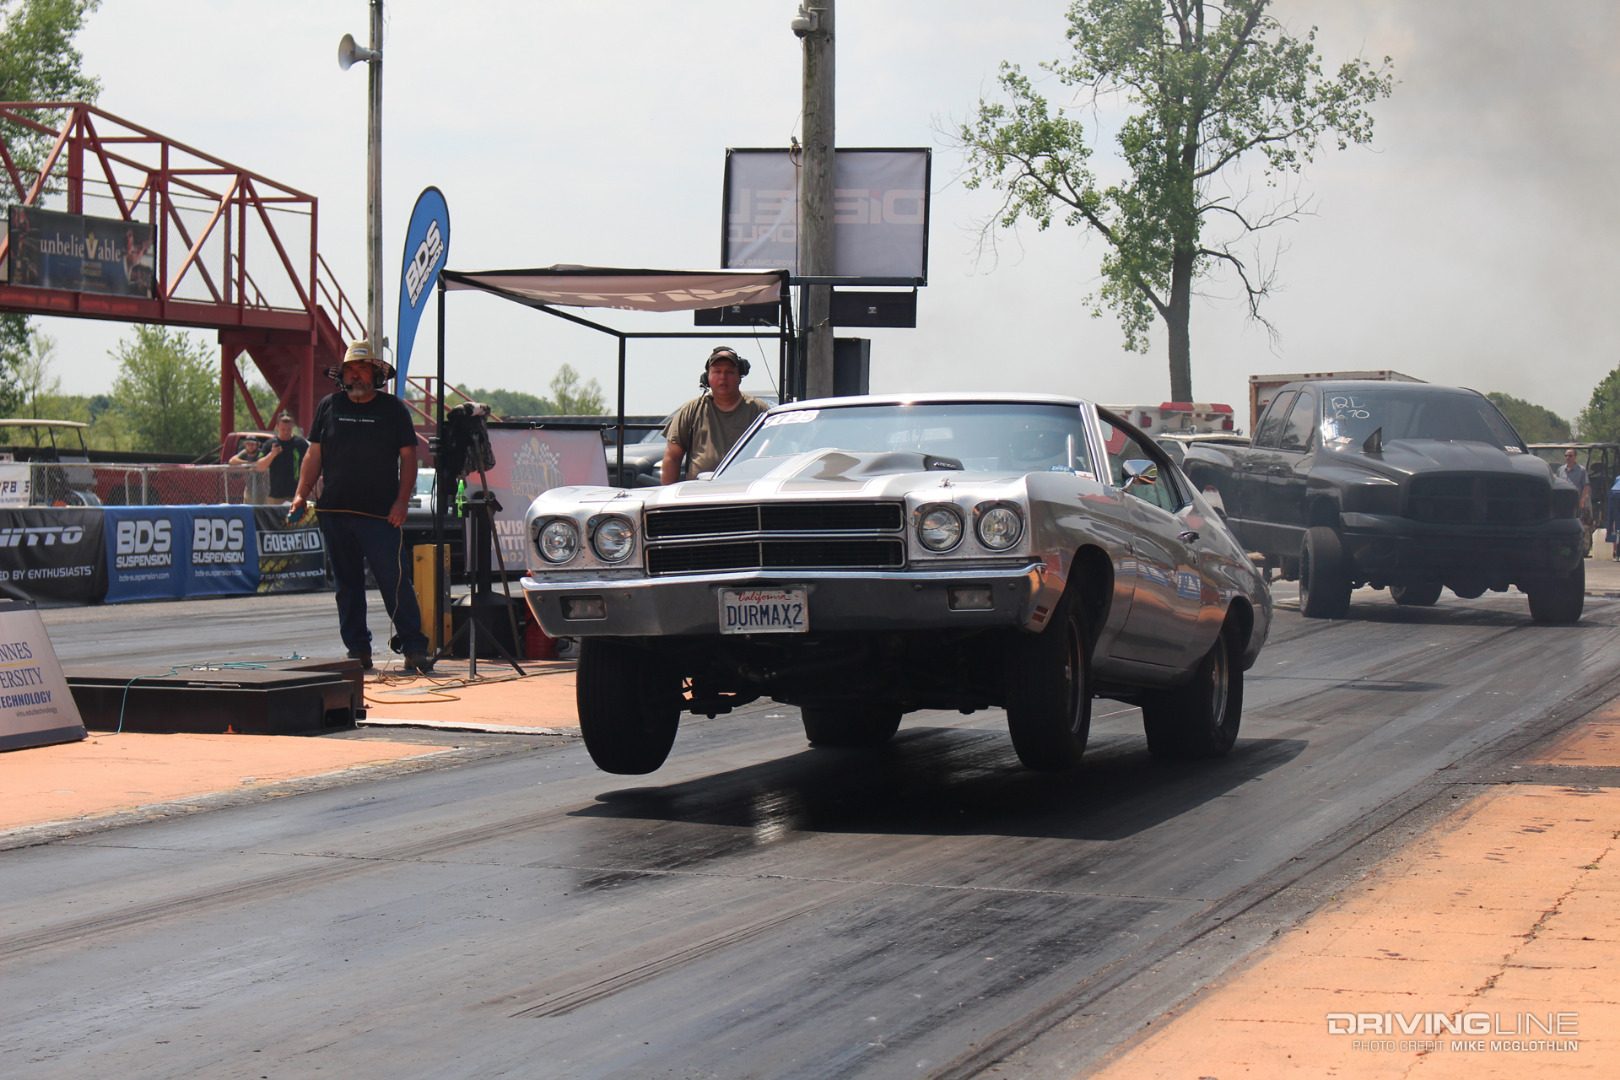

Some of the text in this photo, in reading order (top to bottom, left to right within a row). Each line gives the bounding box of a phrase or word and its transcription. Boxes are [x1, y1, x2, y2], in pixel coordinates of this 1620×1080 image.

[405, 220, 441, 299] BDS
[410, 240, 444, 308] SUSPENSION
[116, 519, 171, 554] BDS
[192, 518, 243, 550] BDS
[116, 553, 171, 568] SUSPENSION
[192, 551, 244, 564] SUSPENSION
[13, 569, 26, 580] BY
[28, 566, 92, 579] ENTHUSIASTS
[738, 591, 787, 604] California
[726, 603, 803, 626] DURMAX2
